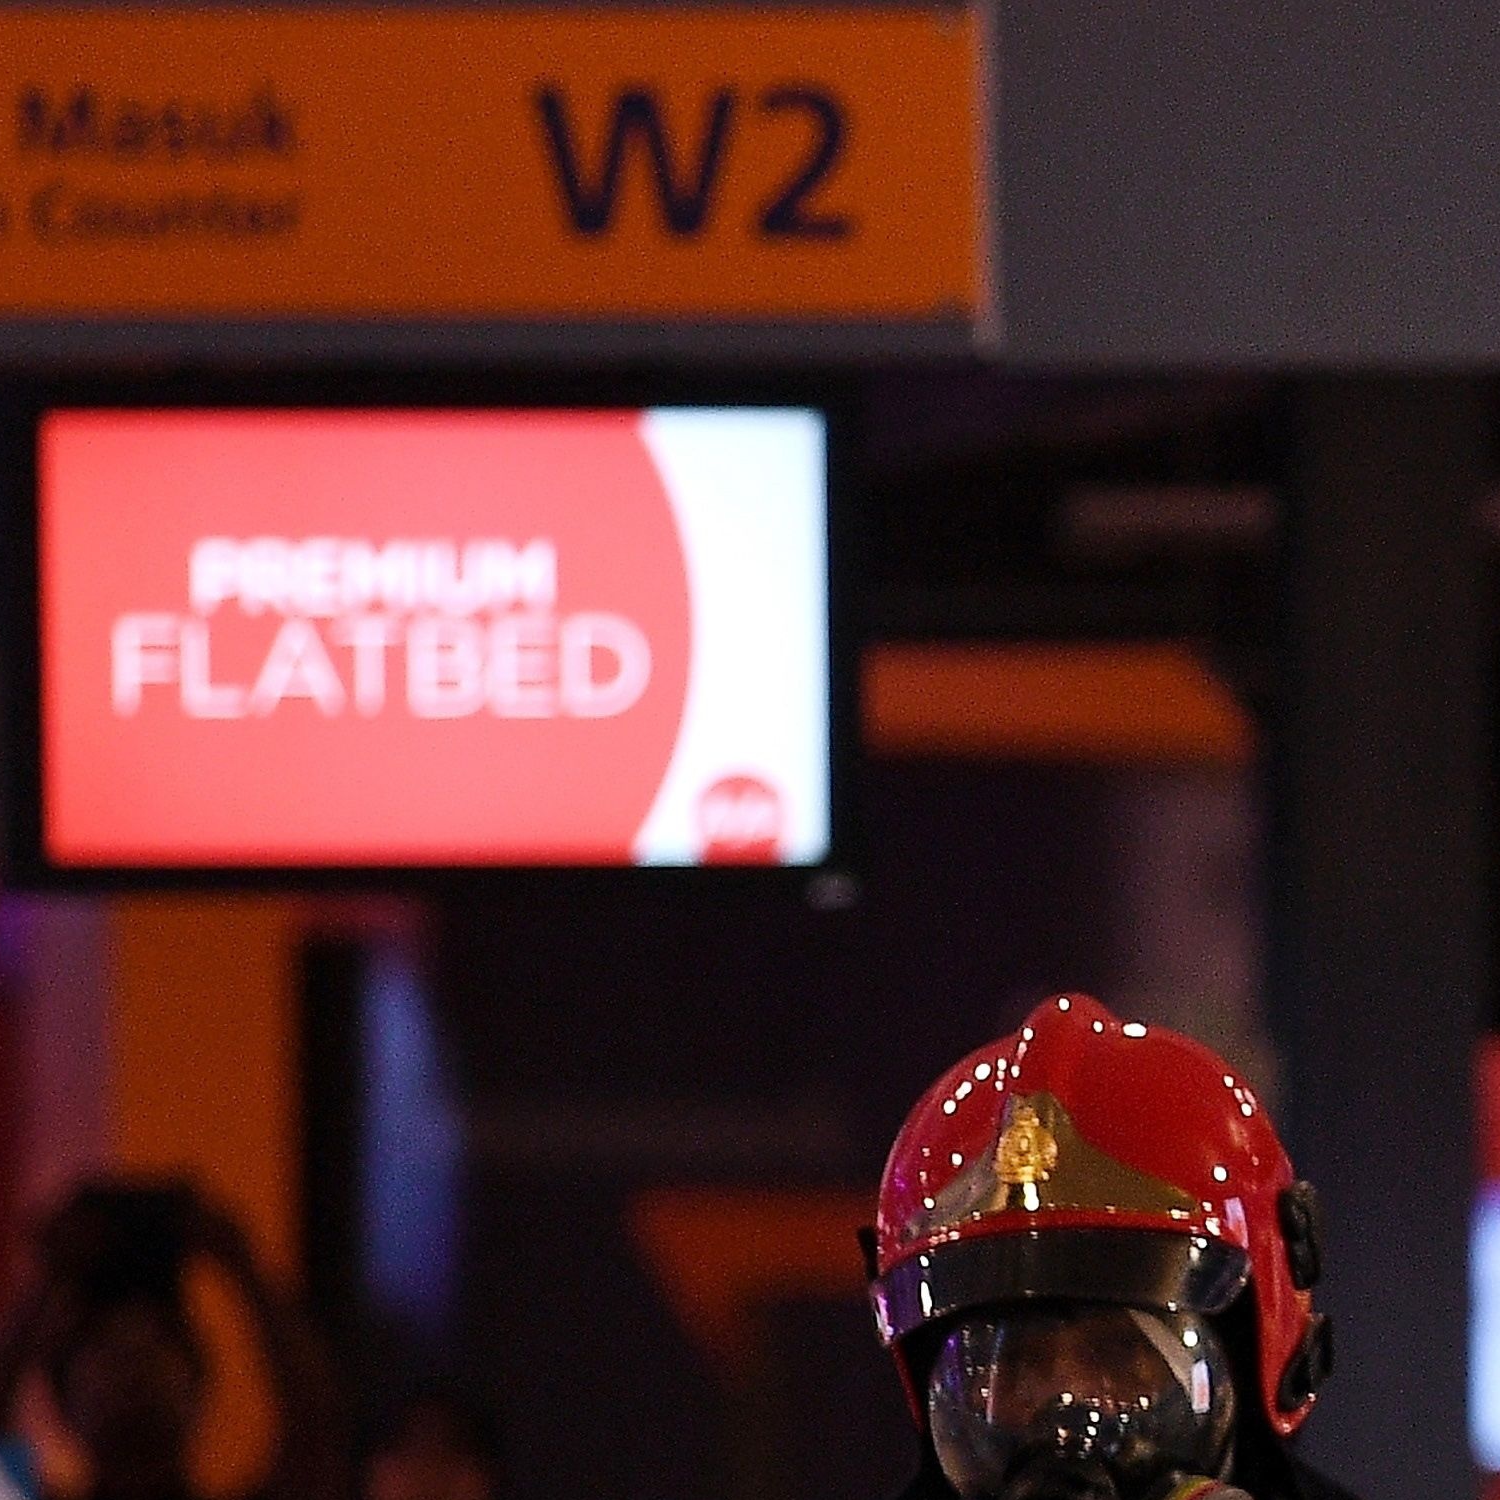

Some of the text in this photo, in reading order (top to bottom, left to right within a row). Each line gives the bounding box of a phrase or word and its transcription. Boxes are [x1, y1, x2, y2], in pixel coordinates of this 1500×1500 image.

[17, 81, 297, 159] Masuk
[537, 80, 857, 237] W2
[189, 537, 557, 616] PREMIUM
[110, 610, 652, 719] FLATBED
